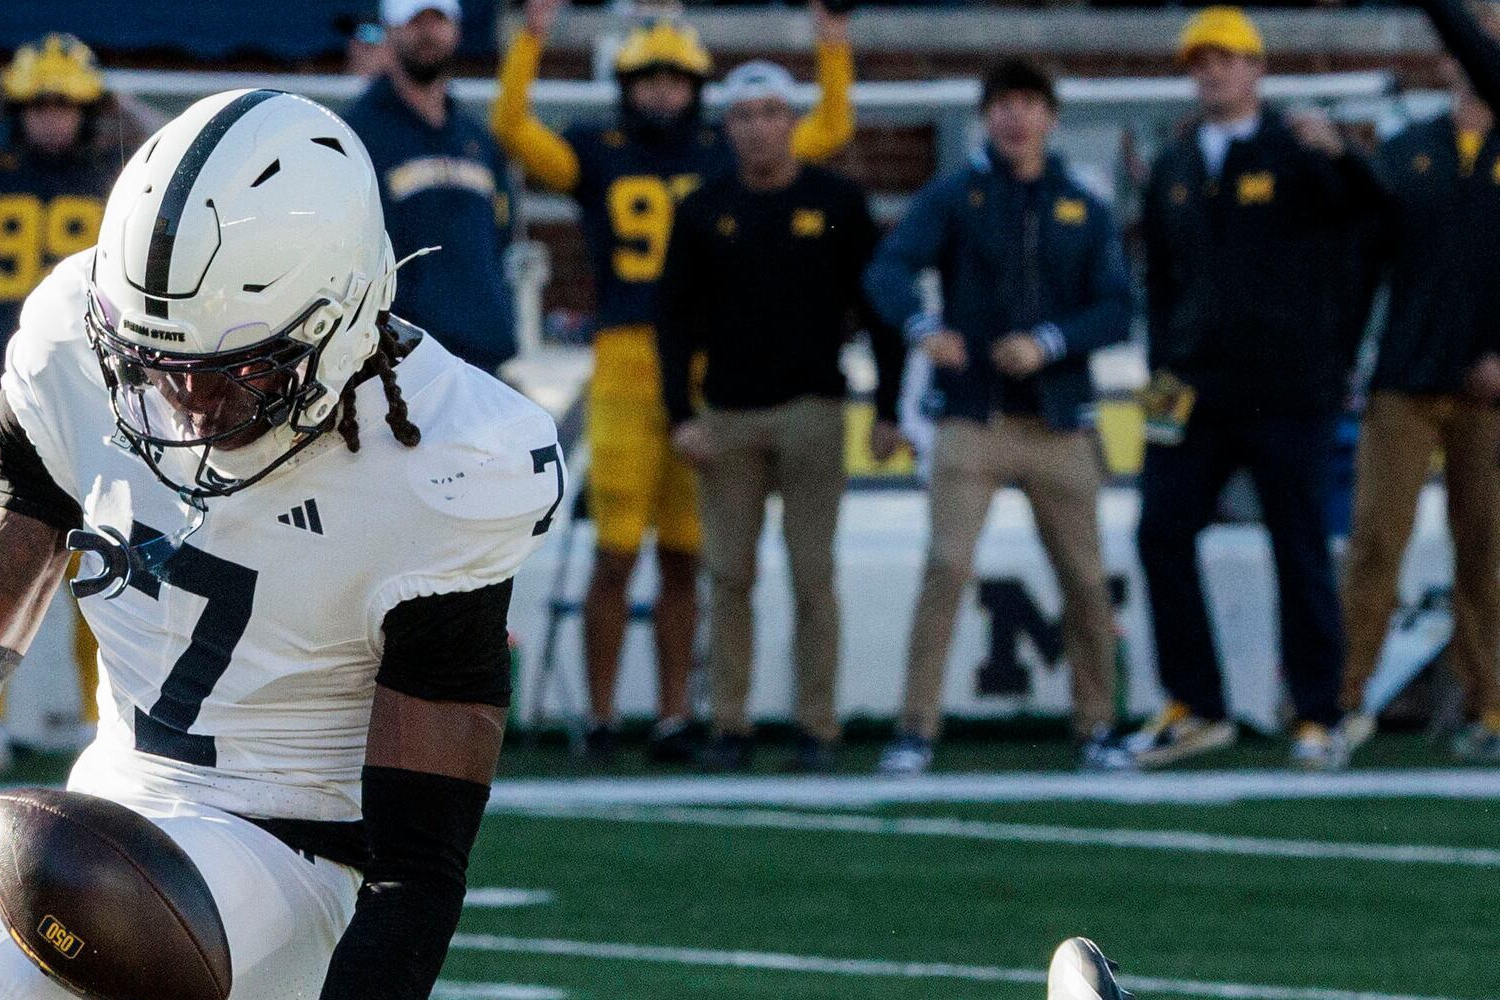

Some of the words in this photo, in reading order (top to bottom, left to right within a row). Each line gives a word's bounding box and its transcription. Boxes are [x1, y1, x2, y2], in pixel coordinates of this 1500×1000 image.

[150, 329, 186, 342] STATE
[530, 443, 564, 536] 7
[129, 520, 259, 768] 7
[46, 922, 74, 952] 050
